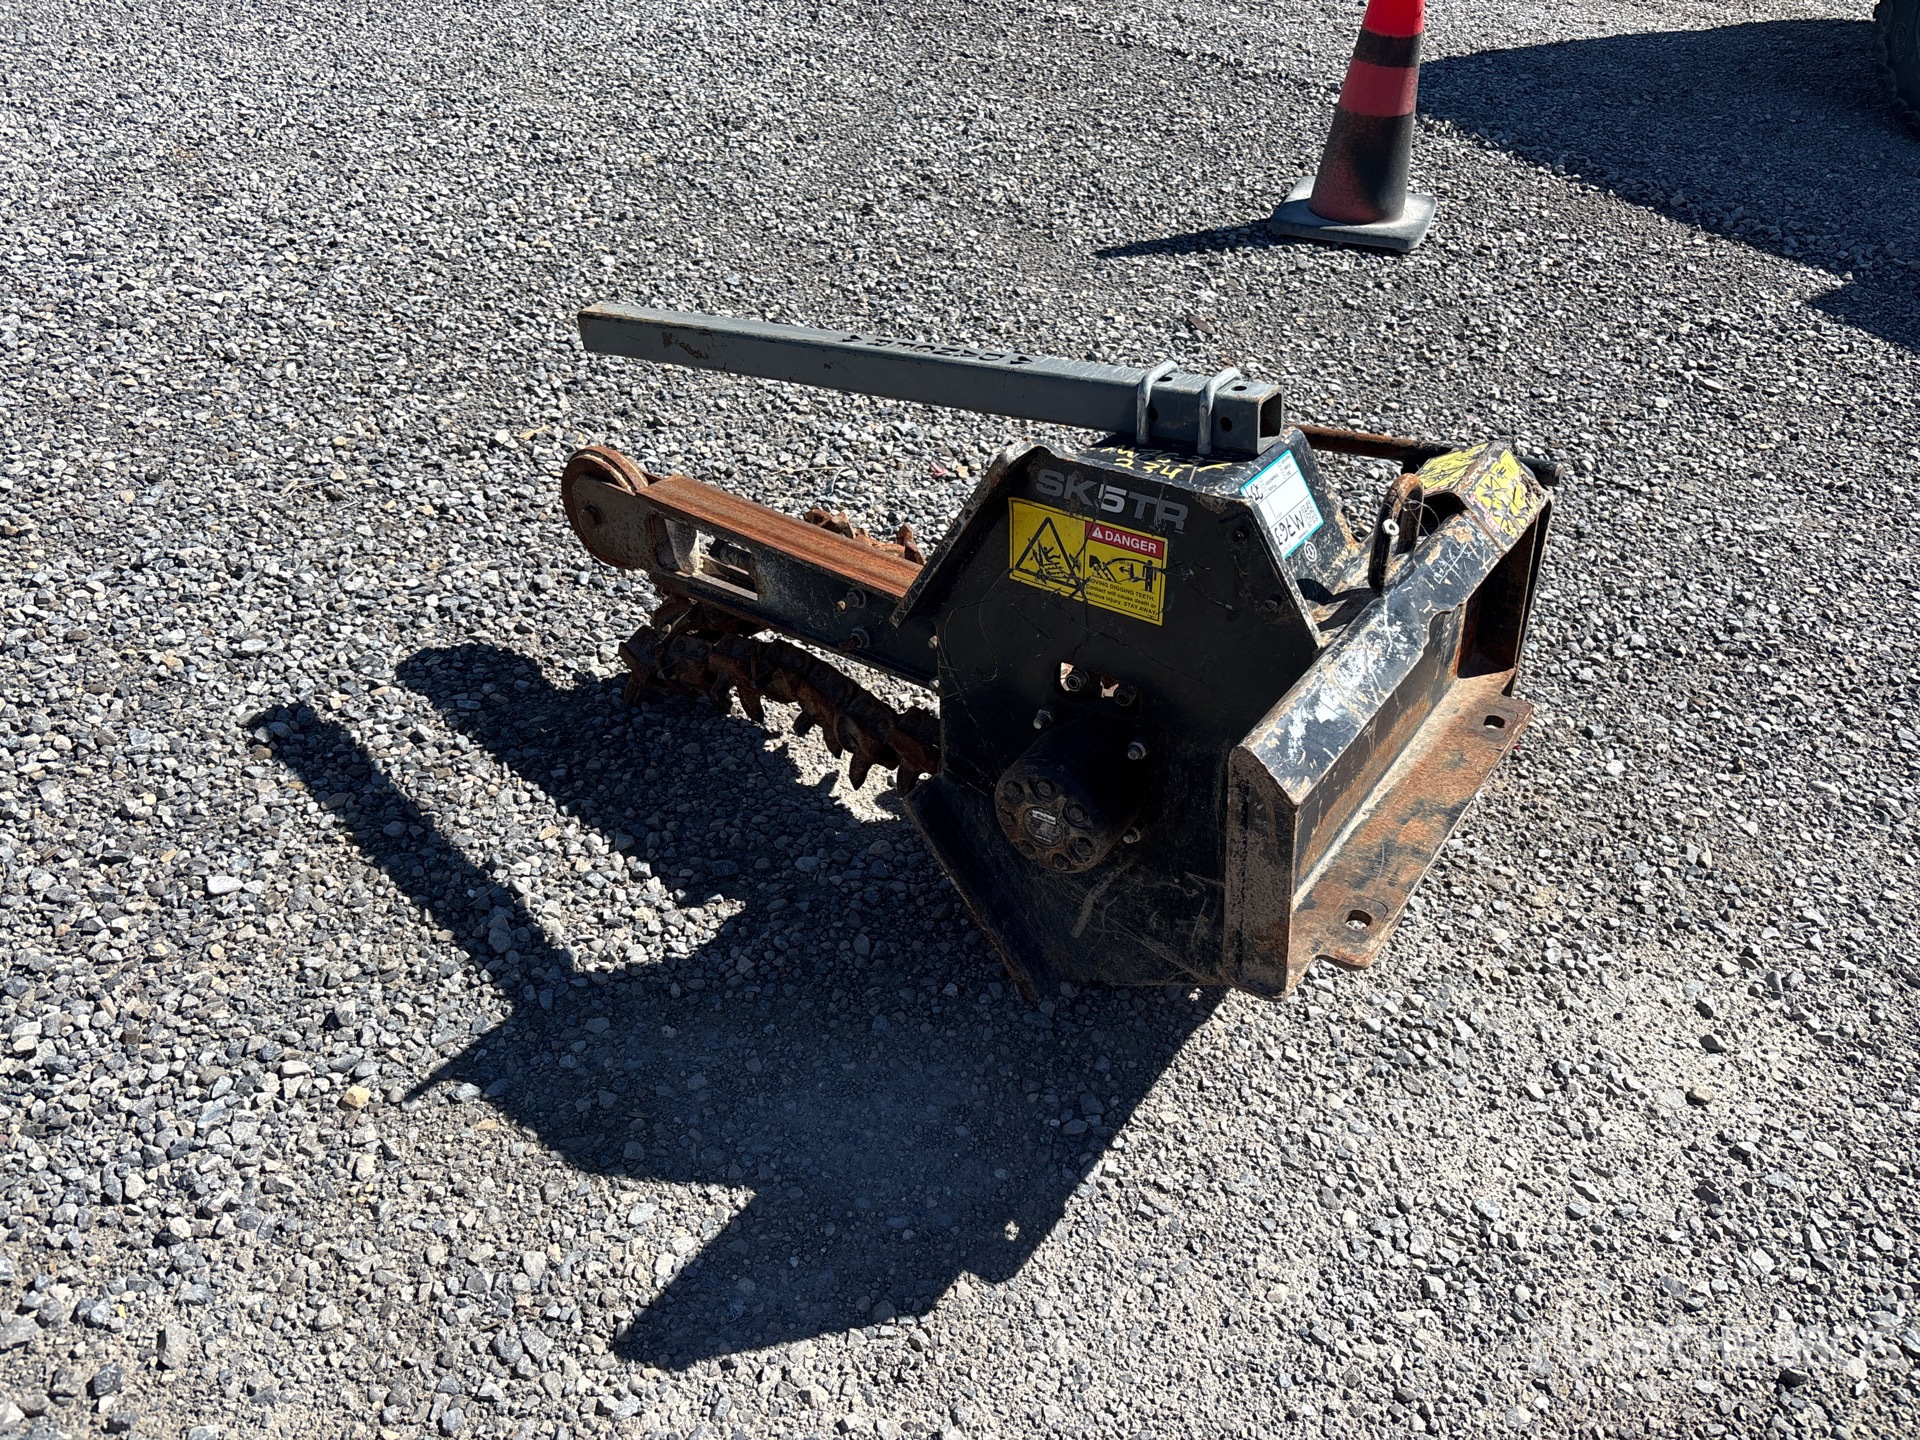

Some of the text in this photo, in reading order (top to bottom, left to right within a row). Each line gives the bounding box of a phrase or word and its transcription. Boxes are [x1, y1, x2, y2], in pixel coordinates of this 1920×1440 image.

[1035, 468, 1189, 531] SK5TR
[1104, 530, 1157, 554] DANGER
[1085, 583, 1107, 594] Contact
[1117, 594, 1134, 602] cause
[1134, 597, 1150, 606] death
[1087, 577, 1109, 588] OVING
[1109, 584, 1135, 596] DIGGING
[1085, 590, 1105, 601] serious
[1123, 601, 1139, 610] STAY
